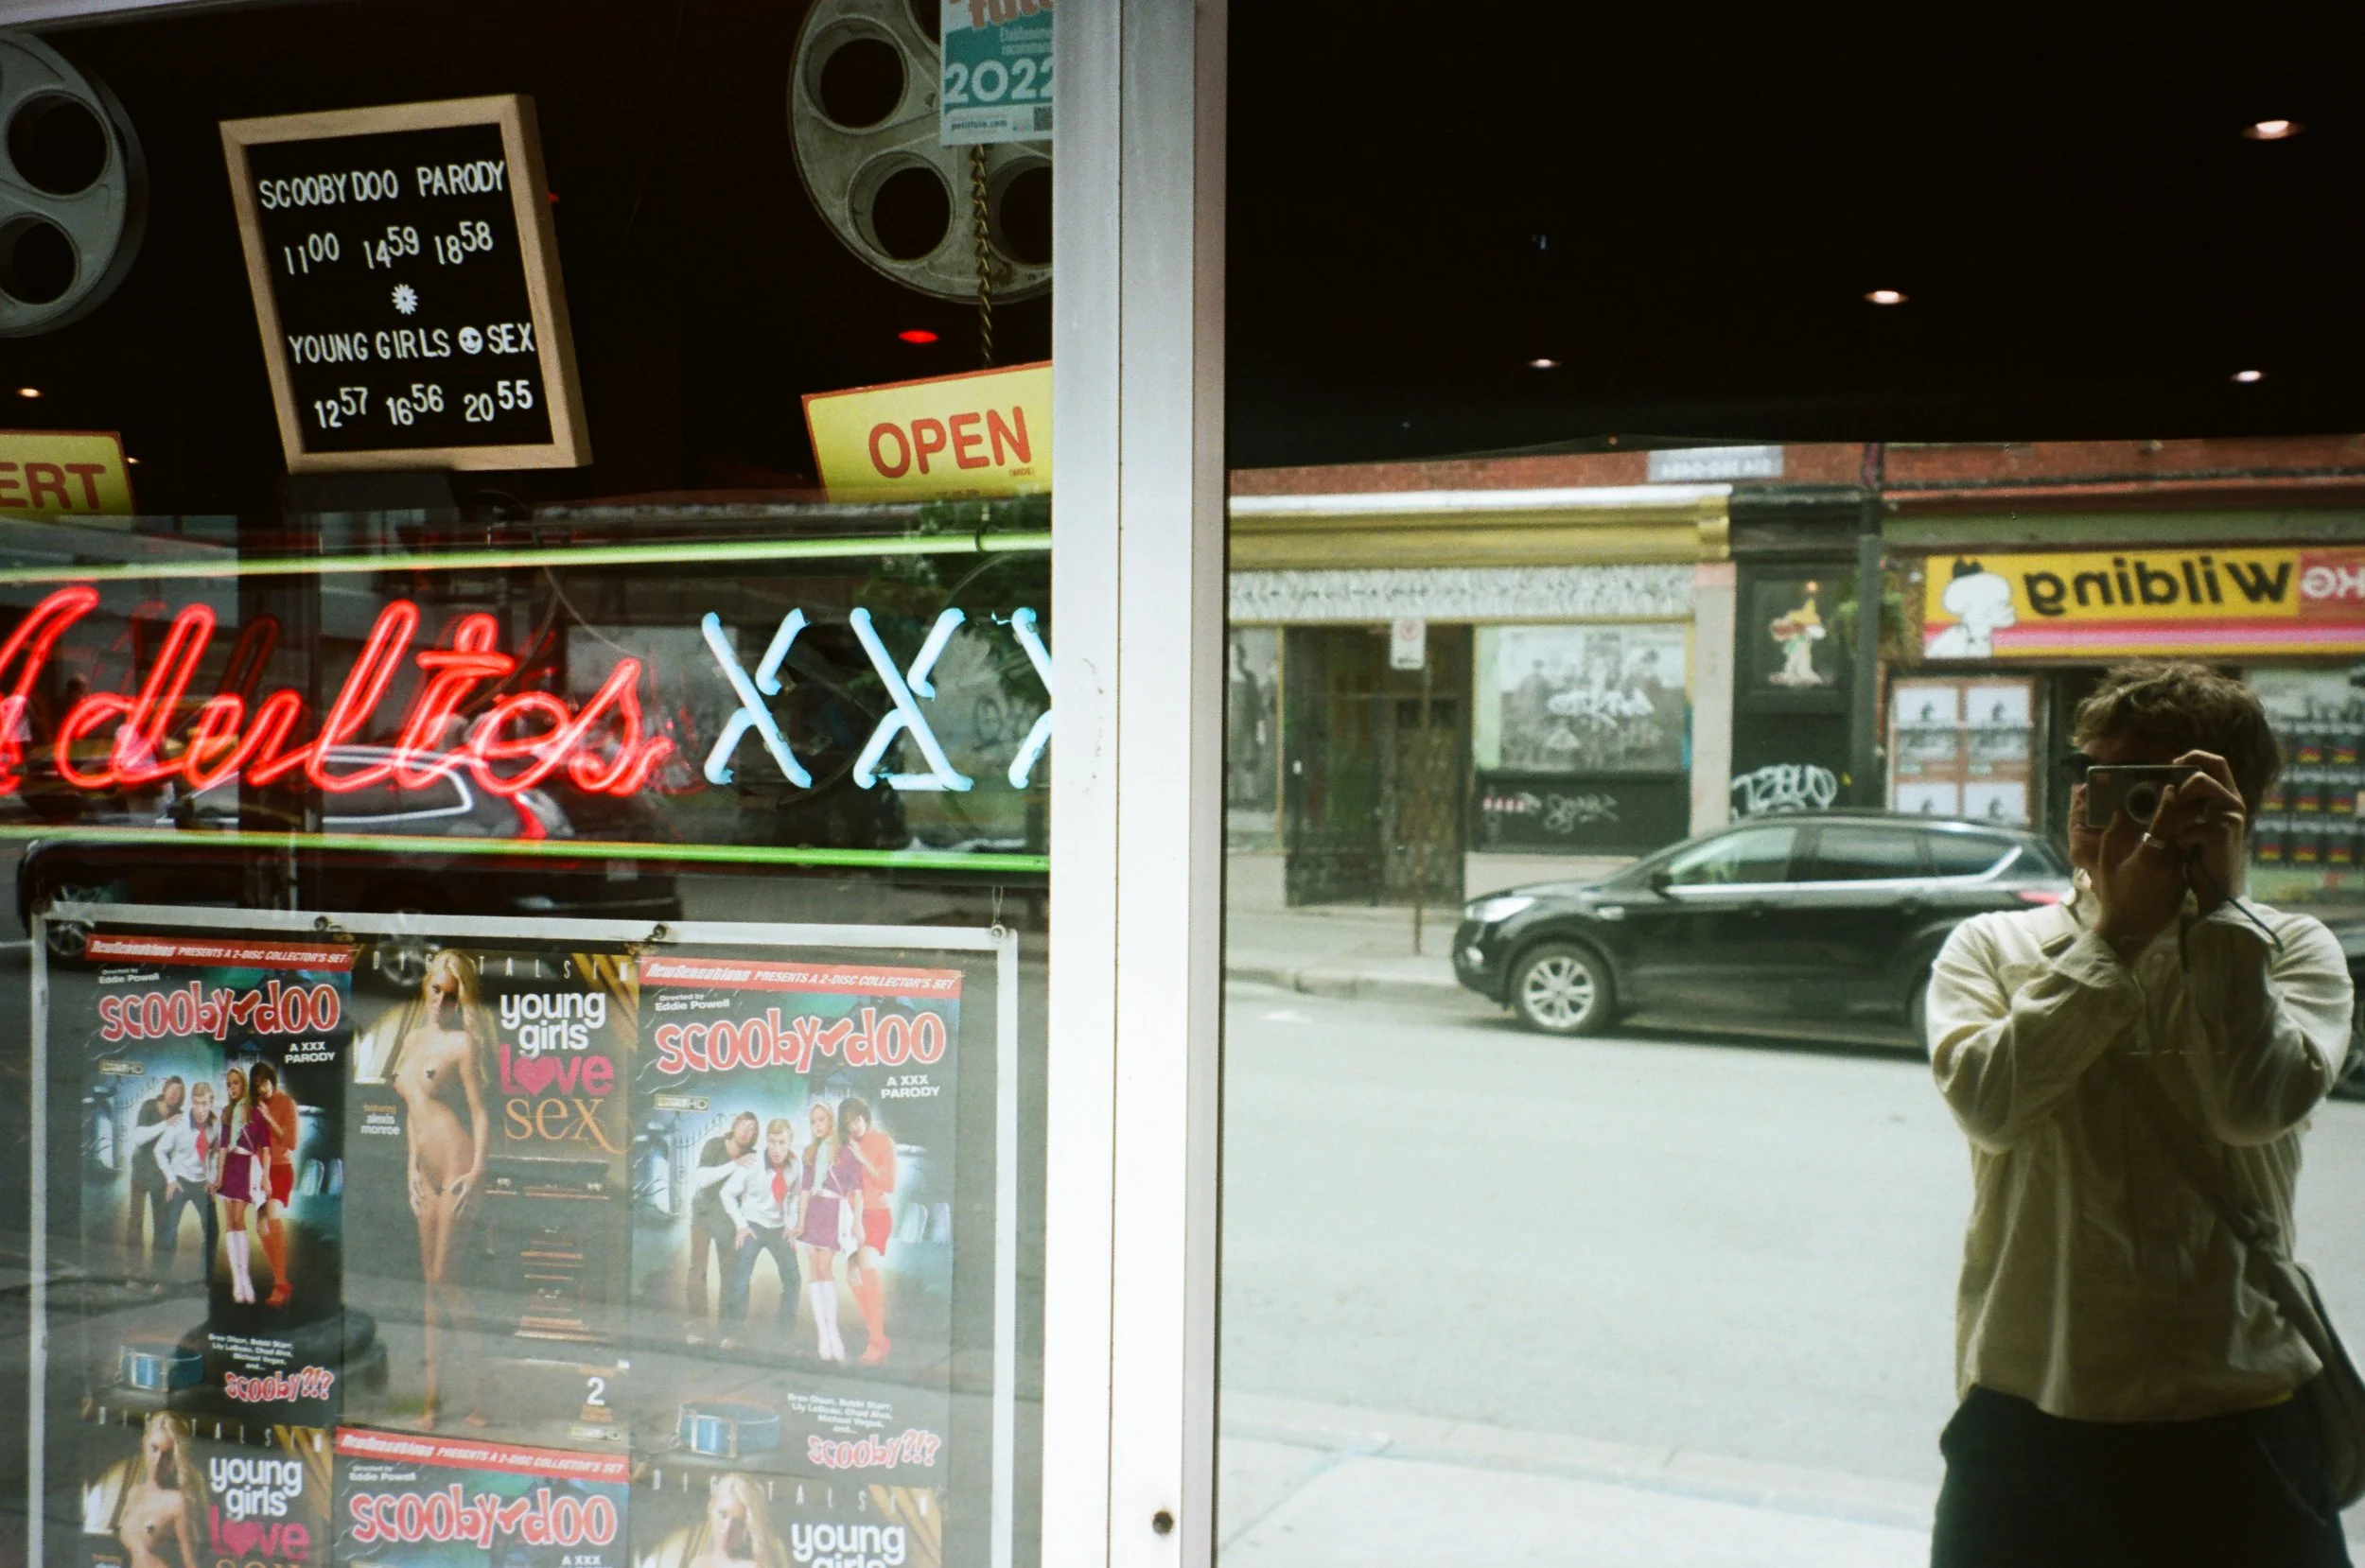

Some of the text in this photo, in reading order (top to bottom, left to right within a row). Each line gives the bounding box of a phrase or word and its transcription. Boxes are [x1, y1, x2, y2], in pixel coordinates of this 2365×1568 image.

[416, 161, 505, 198] PARODY
[289, 322, 535, 364] YOUNG GIRLS SEX
[868, 405, 1032, 479] OPEN
[754, 971, 806, 983] PRESENTS
[808, 974, 818, 984] A
[819, 975, 856, 986] 2-DISC
[858, 977, 931, 989] COLLECTOR'S
[933, 980, 954, 990] SET
[500, 993, 605, 1030] young
[655, 999, 730, 1012] Eddie Powell
[289, 1042, 325, 1053] A XXX
[518, 1019, 588, 1059] girls
[286, 1053, 335, 1064] PARODY
[881, 1087, 940, 1099] PARODY
[886, 1074, 929, 1086] A XXX
[360, 1125, 401, 1136] monroe
[504, 1098, 628, 1155] sex
[587, 1377, 605, 1405] 2
[210, 1457, 303, 1497] young
[226, 1485, 288, 1522] girls
[791, 1523, 905, 1565] young
